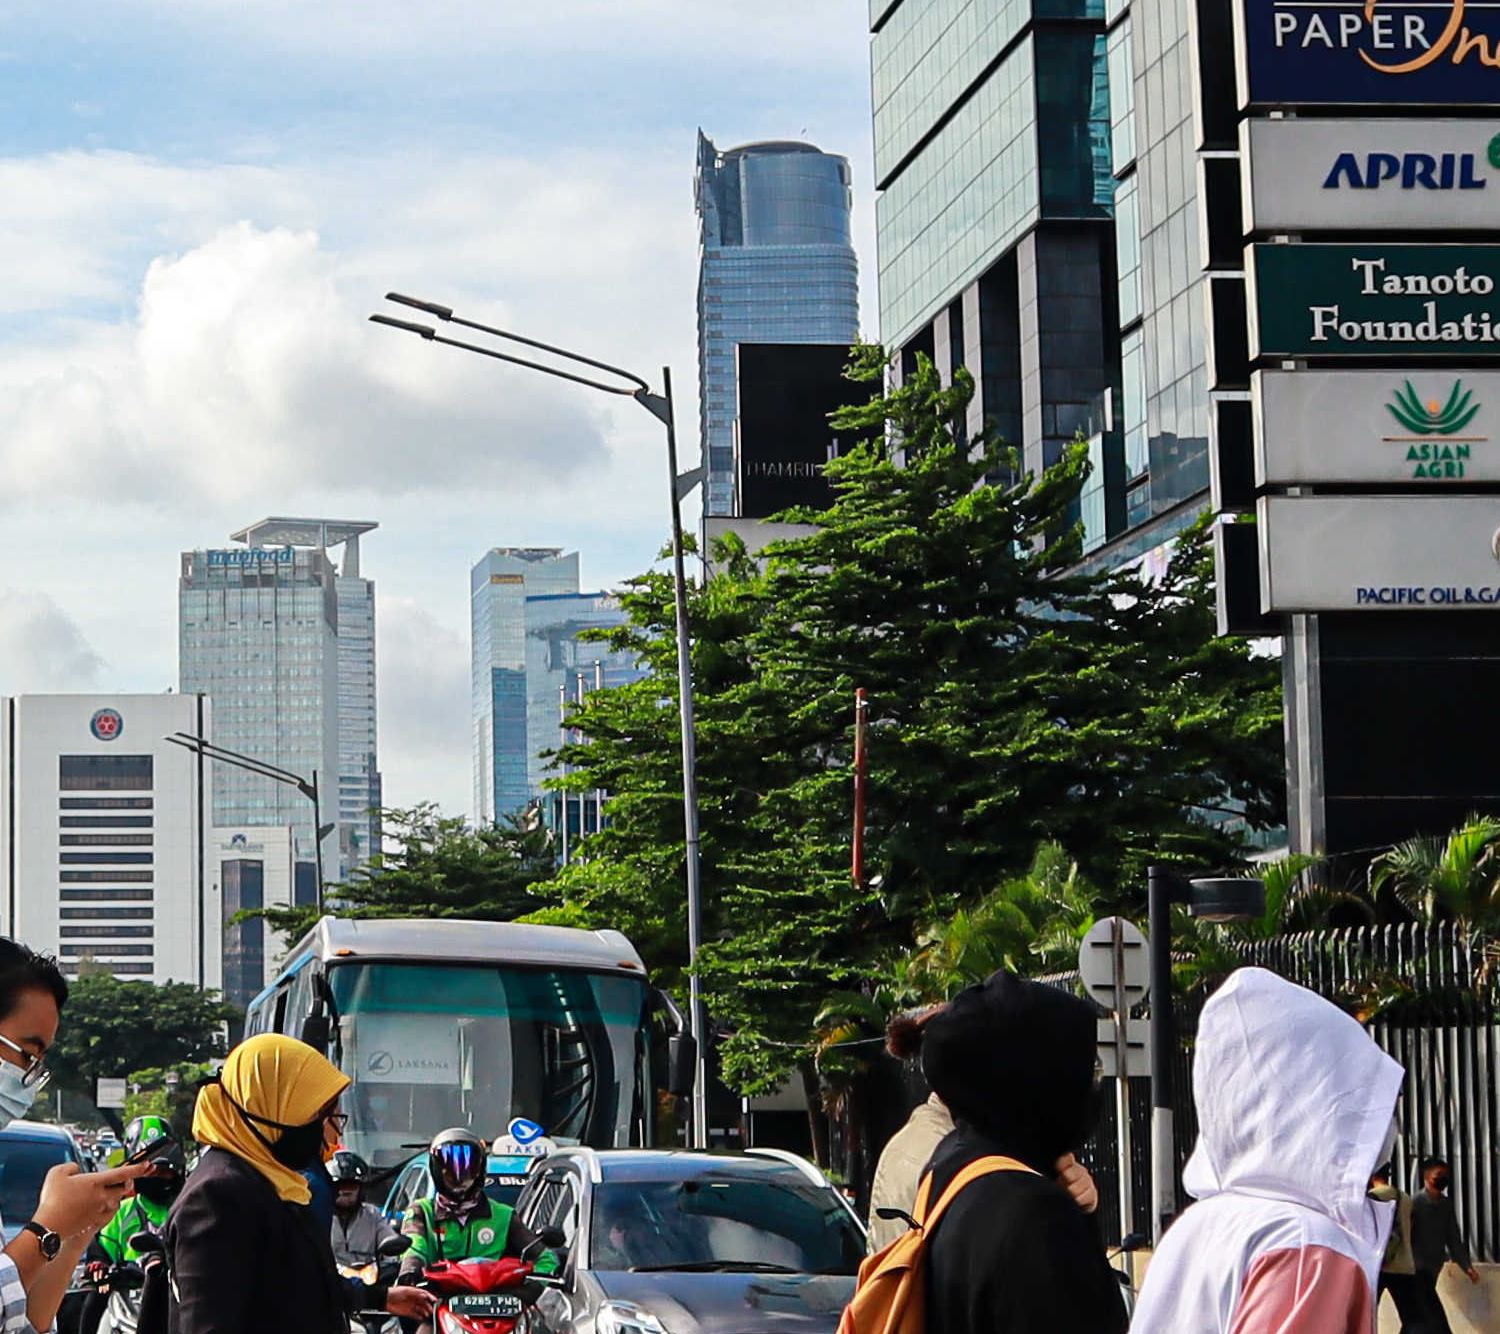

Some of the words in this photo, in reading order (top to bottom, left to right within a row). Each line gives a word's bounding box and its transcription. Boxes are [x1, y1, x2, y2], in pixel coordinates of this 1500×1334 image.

[1274, 12, 1432, 49] PAPER
[1322, 153, 1487, 189] APRIL
[1352, 258, 1494, 295] Tanoto
[1406, 444, 1471, 461] ASIAN
[1413, 461, 1465, 478] AGRI
[1356, 587, 1426, 604] PACIFIC
